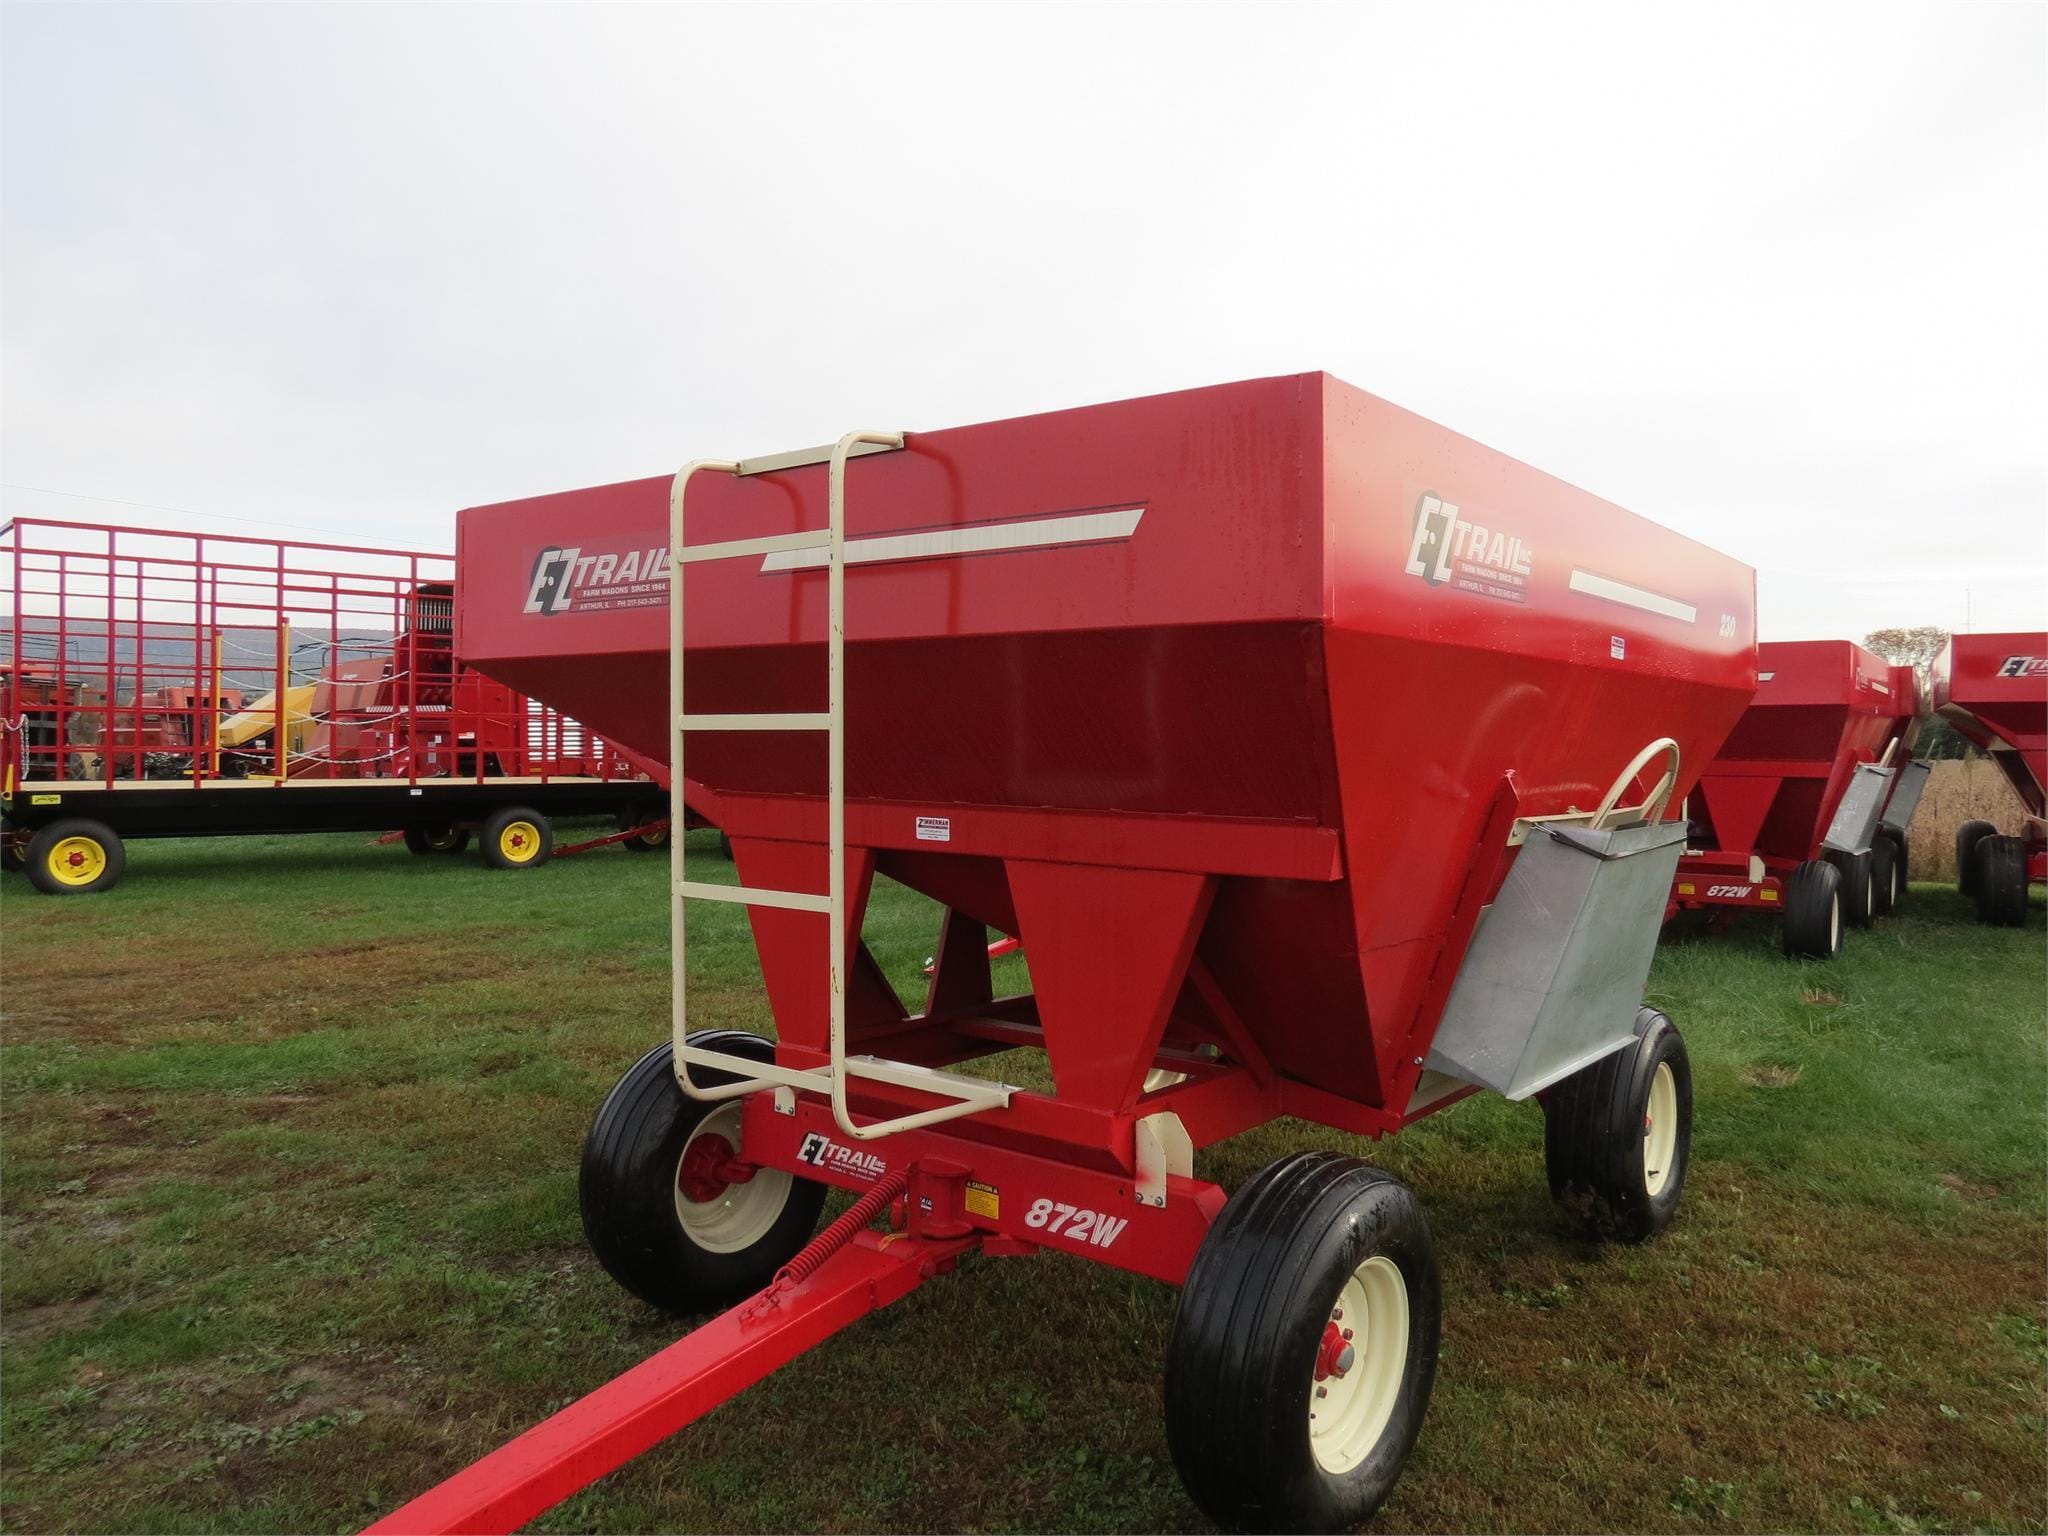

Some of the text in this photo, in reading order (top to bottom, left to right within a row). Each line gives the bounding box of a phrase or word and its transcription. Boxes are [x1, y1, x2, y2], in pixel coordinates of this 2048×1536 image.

[1454, 519, 1530, 575] TRAIL
[574, 548, 671, 588] TRAIL
[583, 588, 601, 598] FARM
[601, 586, 628, 597] WAGONS
[631, 584, 650, 593] SINCE
[918, 819, 949, 828] ZIMMERMAN
[1707, 885, 1752, 898] 872W
[826, 1143, 885, 1173] TRAIL
[972, 1182, 993, 1192] CAUTION
[1024, 1198, 1128, 1248] 872W
